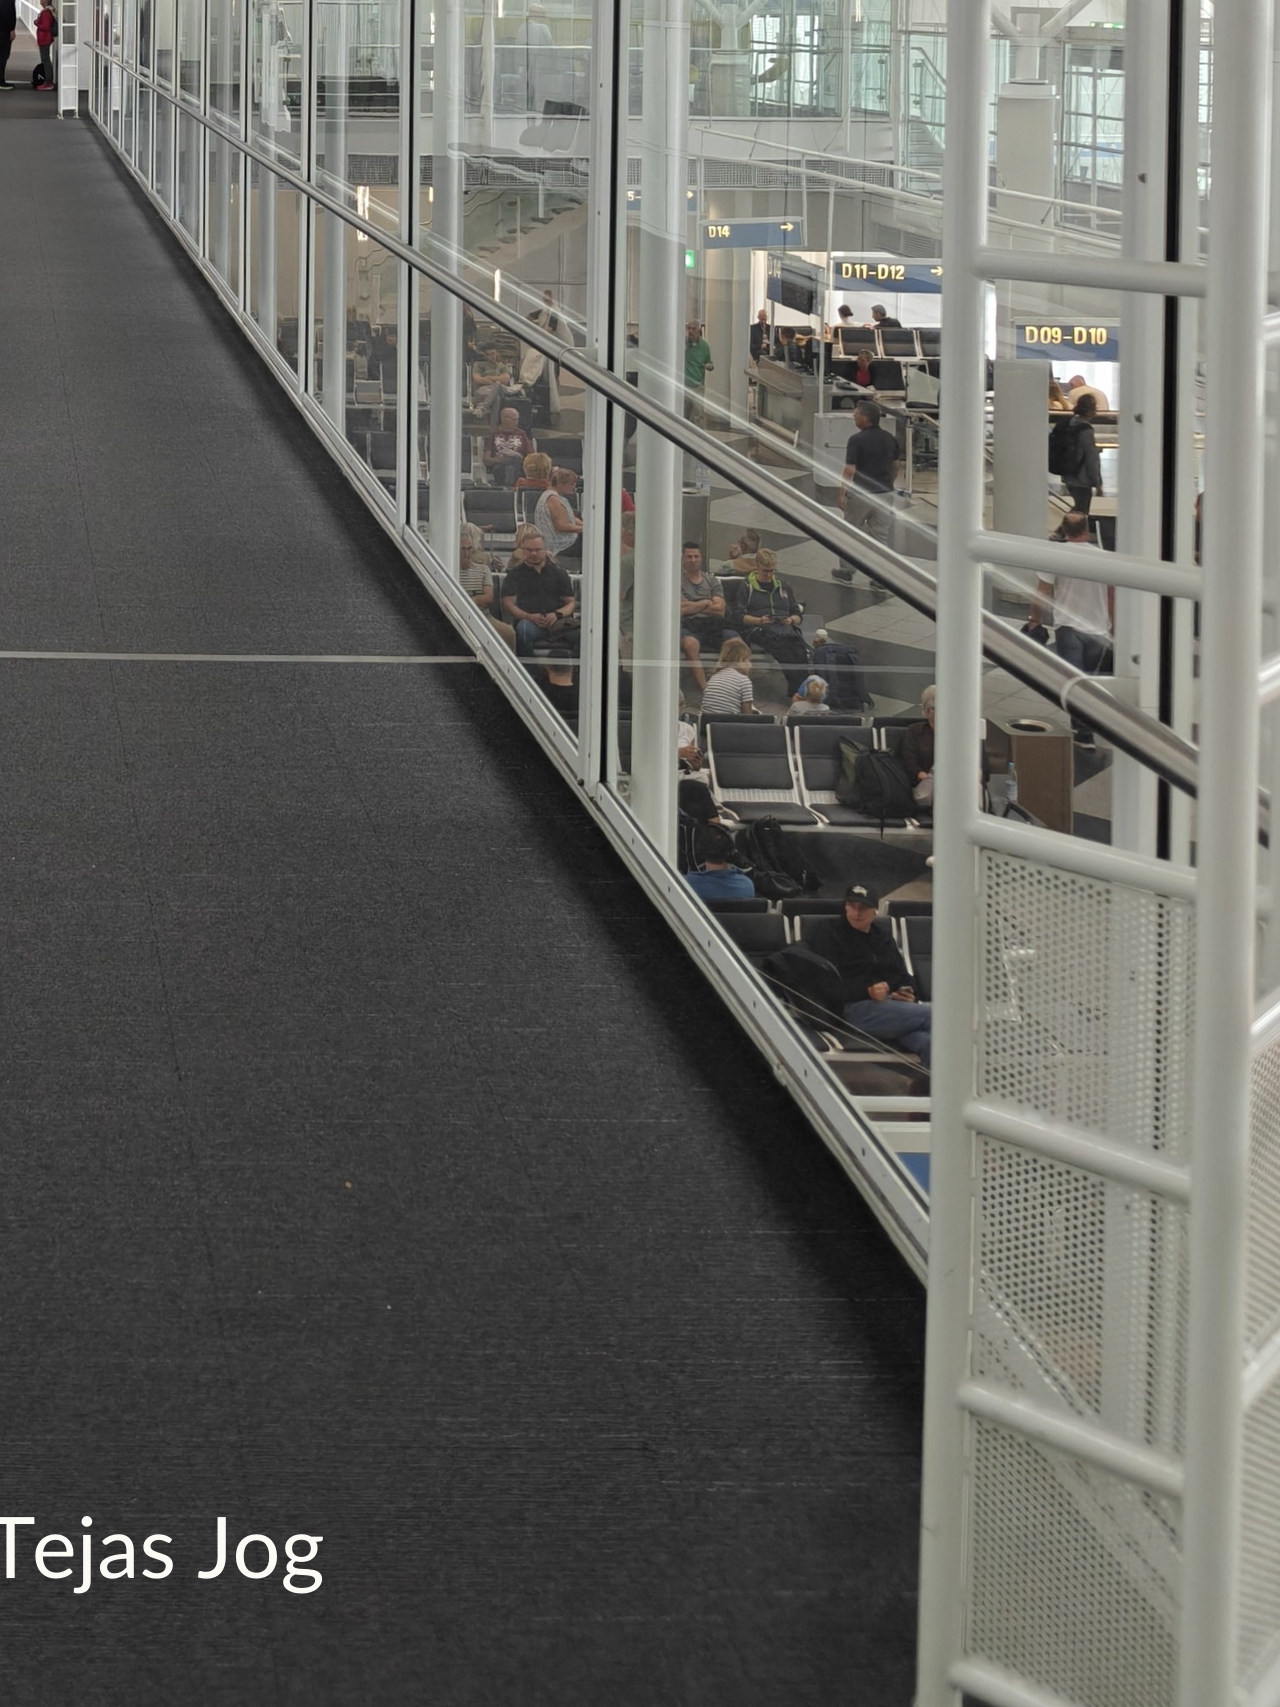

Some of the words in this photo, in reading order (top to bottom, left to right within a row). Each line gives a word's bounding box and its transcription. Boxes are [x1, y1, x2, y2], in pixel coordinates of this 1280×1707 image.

[708, 225, 730, 238] D14
[841, 262, 905, 281] D11-D12
[1024, 325, 1108, 346] D09-D10
